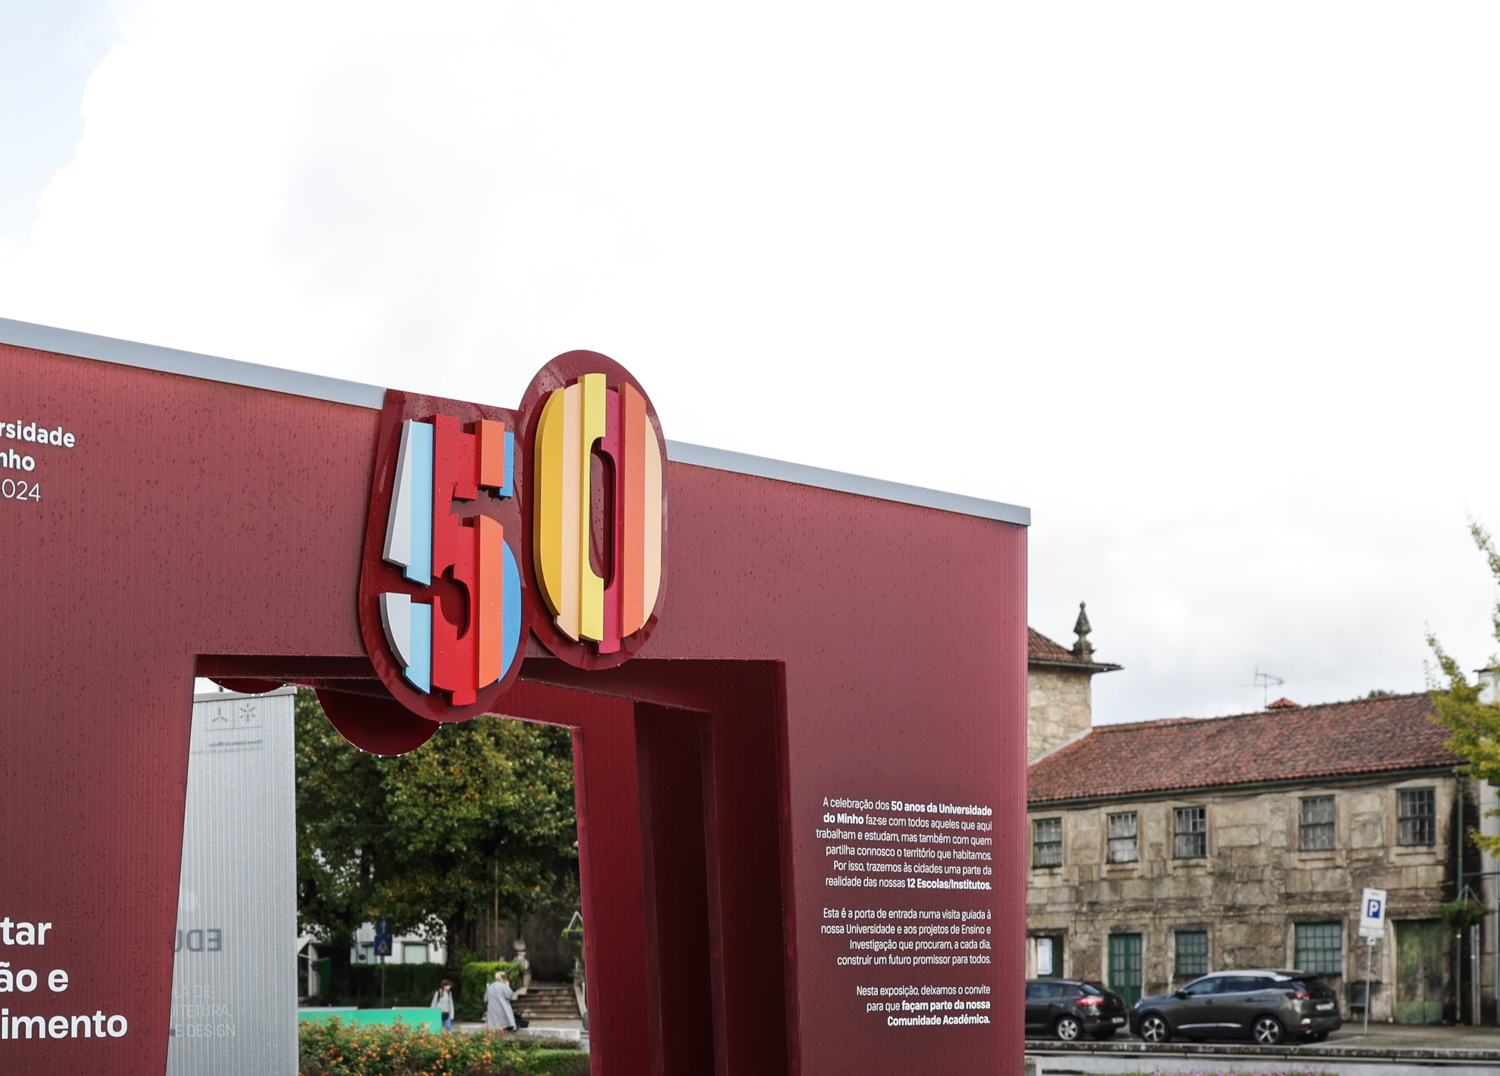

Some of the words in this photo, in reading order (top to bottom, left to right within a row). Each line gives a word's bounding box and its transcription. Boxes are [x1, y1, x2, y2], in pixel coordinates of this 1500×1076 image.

[380, 372, 662, 706] 50
[823, 797, 829, 807] A
[830, 797, 874, 811] celebração
[875, 800, 890, 810] dos
[891, 801, 903, 811] 50
[904, 803, 925, 812] anos
[927, 802, 937, 813] da
[939, 803, 992, 816] Universidade
[823, 812, 835, 823] do
[837, 813, 864, 824] Minho
[866, 814, 887, 825] faz-se
[889, 818, 906, 826] com
[908, 817, 929, 828] todos
[931, 819, 959, 830] aqueles
[961, 821, 975, 831] que
[976, 821, 992, 832] aqui
[816, 828, 856, 839] trabalham
[857, 832, 863, 840] e
[864, 831, 900, 842] estudam,
[901, 834, 917, 843] mas
[919, 833, 951, 844] também
[952, 836, 969, 844] com
[970, 837, 992, 847] quem
[826, 845, 855, 856] partilha
[856, 847, 895, 857] connosco
[897, 849, 902, 857] o
[903, 847, 935, 858] território
[937, 851, 951, 861] que
[953, 849, 992, 860] habitamos.
[833, 860, 847, 870] Por
[848, 861, 865, 872] isso,
[866, 862, 902, 872] trazemos
[903, 862, 912, 873] às
[913, 863, 943, 873] cidades
[944, 866, 961, 874] uma
[963, 866, 981, 876] parte
[983, 865, 992, 875] da
[825, 876, 862, 887] realidade
[863, 877, 877, 887] das
[879, 879, 905, 888] nossas
[907, 878, 916, 888] 12
[917, 878, 992, 890] Escolas/Institutos.
[823, 908, 839, 918] Esta
[841, 908, 846, 918] é
[848, 910, 853, 918] a
[854, 909, 875, 920] porta
[877, 908, 887, 919] de
[888, 909, 917, 919] entrada
[919, 910, 940, 919] numa
[942, 909, 960, 919] visita
[961, 910, 985, 921] guiada
[986, 909, 991, 919] à
[1369, 900, 1380, 917] P
[821, 925, 844, 934] nossa
[846, 924, 896, 934] Universidade
[897, 926, 902, 934] e
[903, 926, 917, 934] aos
[918, 924, 949, 936] projetos
[950, 924, 960, 934] de
[961, 924, 985, 934] Ensino
[986, 926, 991, 934] e
[849, 939, 897, 952] Investigação
[899, 941, 913, 951] que
[915, 941, 953, 951] procuram,
[954, 941, 959, 949] a
[960, 939, 978, 949] cada
[979, 939, 991, 950] dia,
[837, 955, 872, 965] construir
[874, 956, 887, 965] um
[888, 954, 911, 965] futuro
[913, 954, 950, 966] promissor
[952, 955, 968, 966] para
[969, 954, 991, 964] todos.
[47, 968, 69, 992] e
[856, 986, 878, 996] Nesta
[880, 985, 919, 997] exposição,
[920, 985, 956, 995] deixamos
[958, 987, 963, 995] o
[964, 984, 990, 995] convite
[866, 1002, 883, 1013] para
[885, 1002, 900, 1012] que
[902, 1000, 928, 1012] façam
[930, 1001, 952, 1012] parte
[954, 1000, 964, 1010] da
[966, 1001, 990, 1009] nossa
[887, 1015, 941, 1026] Comunidade
[943, 1014, 990, 1025] Académica.
[186, 1024, 236, 1037] DESIGN
